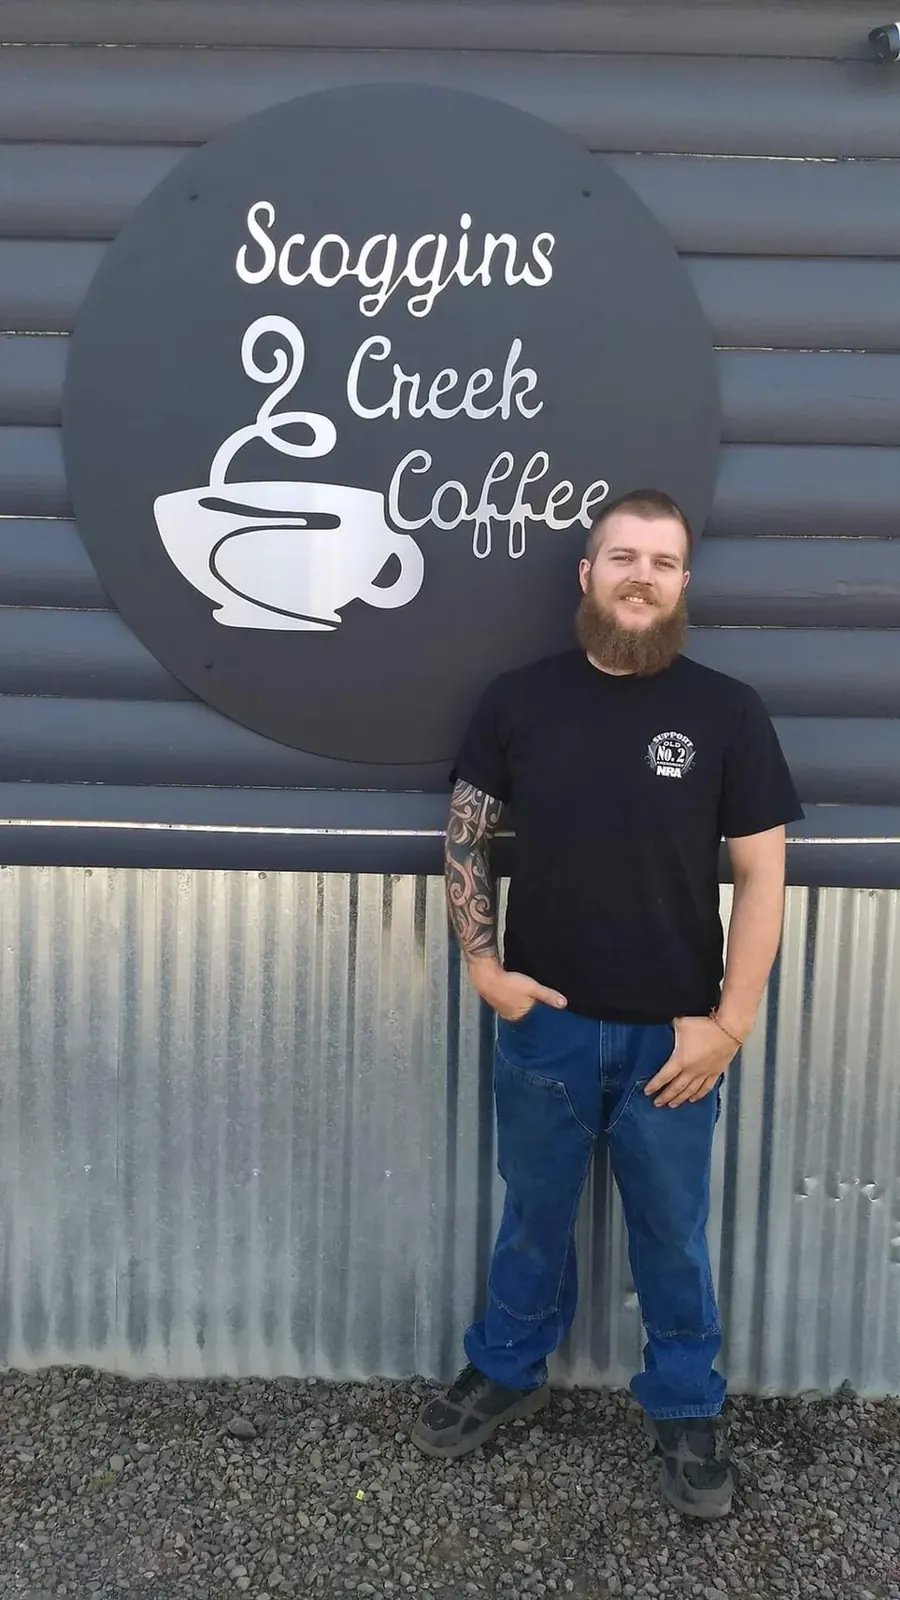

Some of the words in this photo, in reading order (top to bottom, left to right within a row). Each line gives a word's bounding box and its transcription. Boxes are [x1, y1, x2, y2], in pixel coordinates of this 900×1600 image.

[236, 201, 555, 317] Scoggins
[347, 335, 543, 420] Creek
[389, 449, 609, 559] Coffee
[652, 731, 694, 747] SUPPORT
[656, 766, 682, 778] NRA
